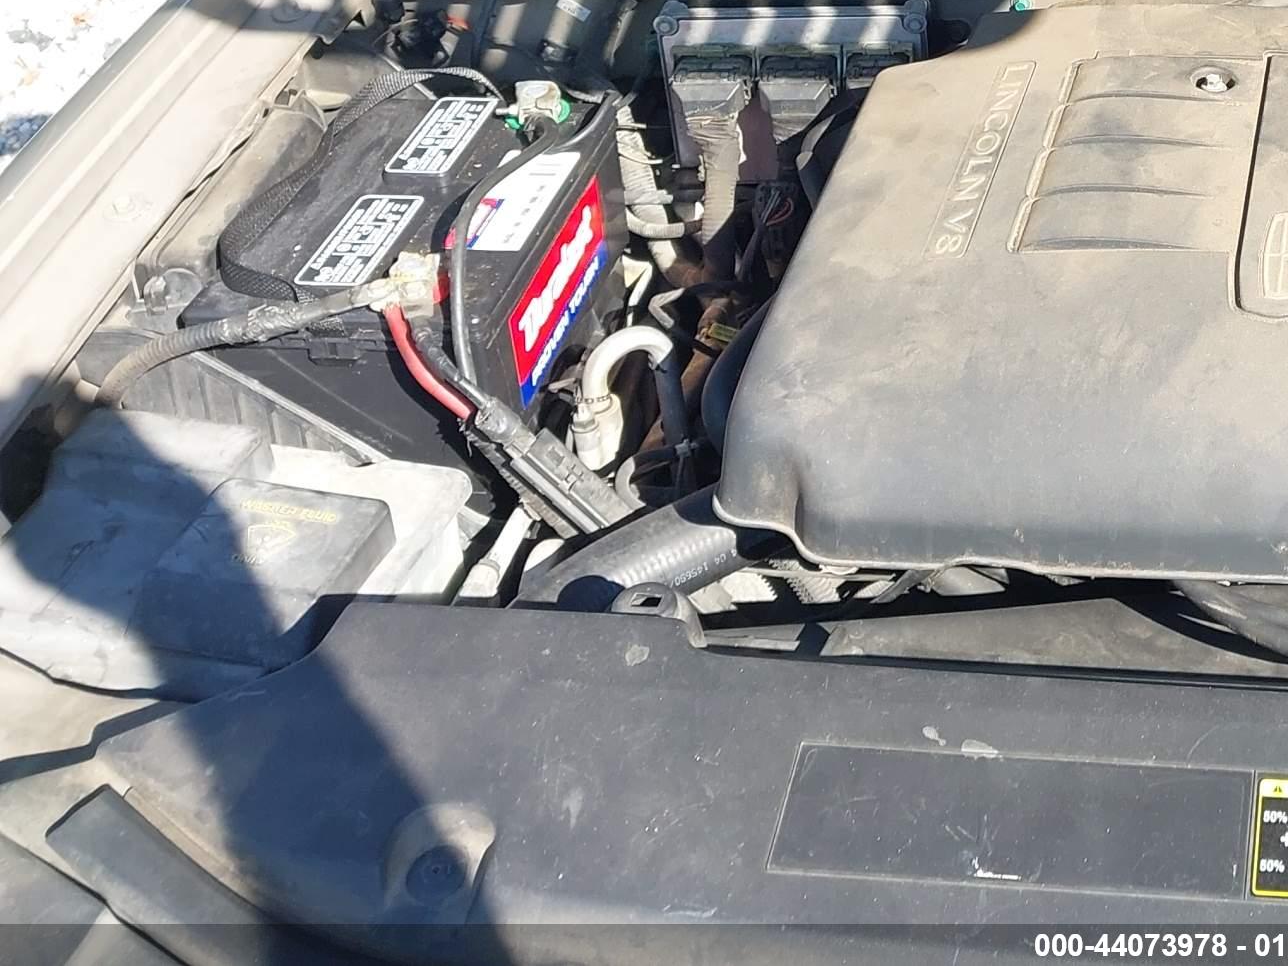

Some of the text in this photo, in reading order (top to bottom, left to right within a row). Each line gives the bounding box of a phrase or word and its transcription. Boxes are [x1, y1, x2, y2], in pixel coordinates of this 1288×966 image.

[936, 64, 1030, 254] LINCOLN V8
[1263, 810, 1288, 824] 50%
[1260, 859, 1285, 873] 50%
